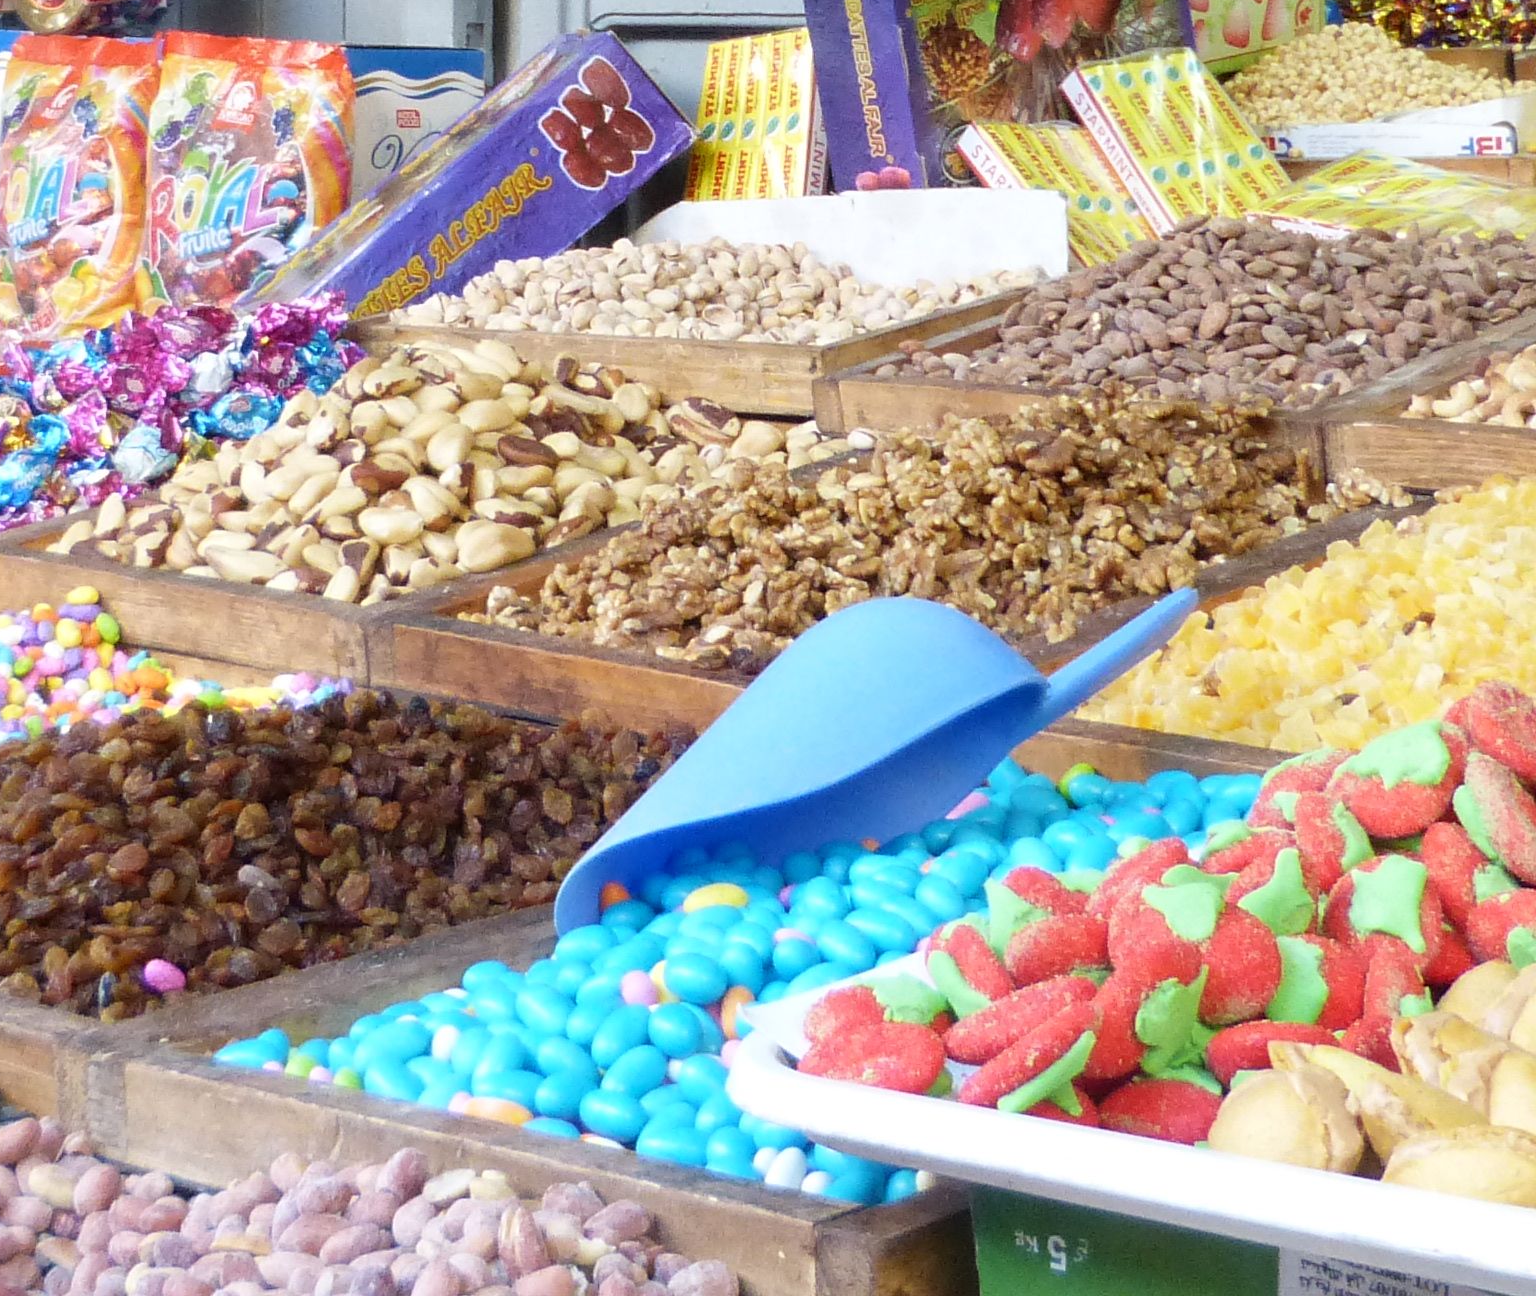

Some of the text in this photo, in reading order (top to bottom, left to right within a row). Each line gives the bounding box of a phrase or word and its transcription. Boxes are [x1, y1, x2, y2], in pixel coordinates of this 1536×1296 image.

[1075, 92, 1133, 184] STARMINT
[150, 157, 282, 271] ROYAL
[1014, 1229, 1067, 1272] 5 Kg
